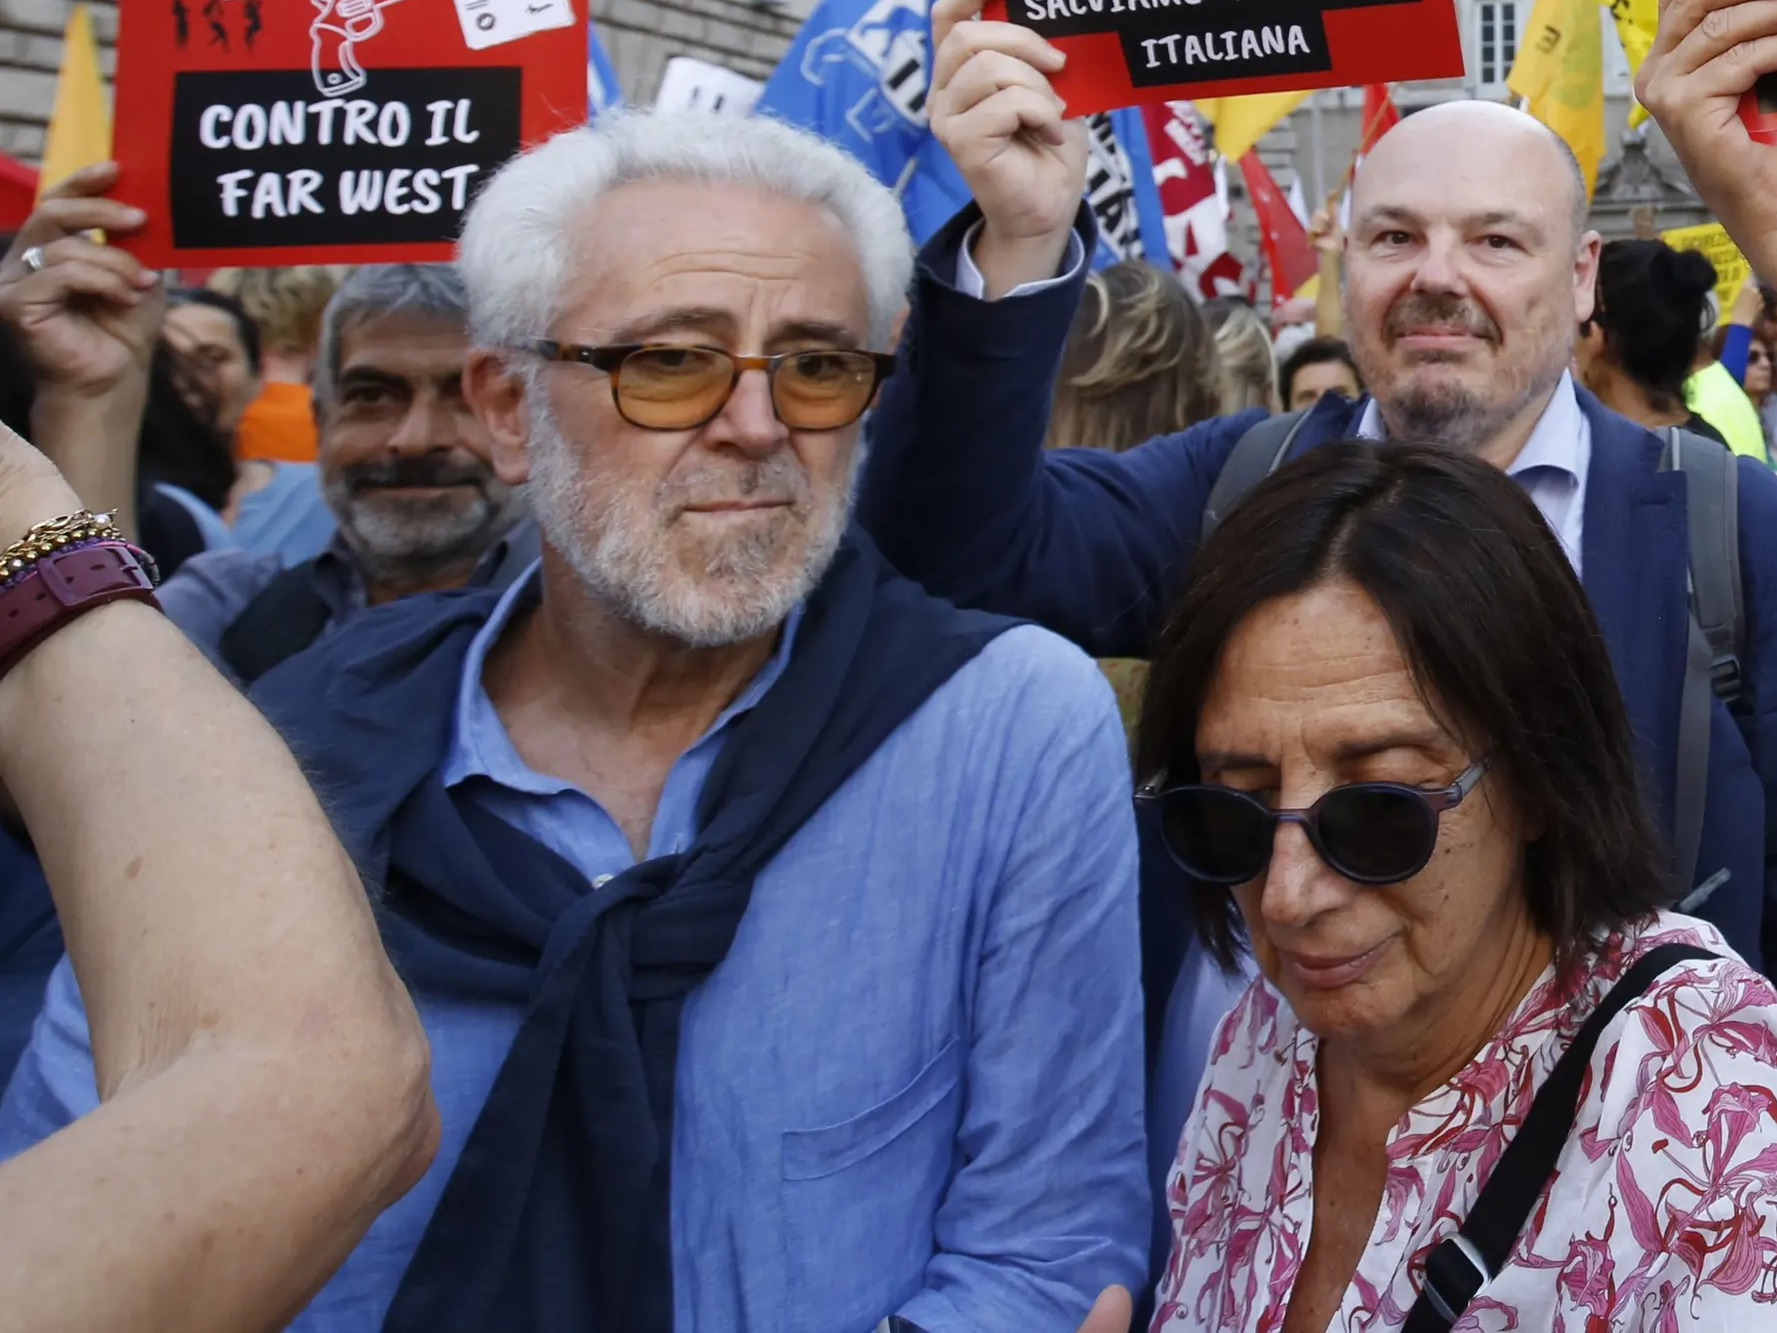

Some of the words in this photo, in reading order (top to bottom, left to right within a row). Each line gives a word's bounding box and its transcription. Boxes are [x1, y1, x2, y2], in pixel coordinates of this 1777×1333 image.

[1140, 24, 1311, 68] ITALIANA
[200, 99, 411, 151] CONTRO
[424, 98, 480, 146] IL
[216, 169, 324, 219] FAR
[339, 163, 480, 215] WEST
